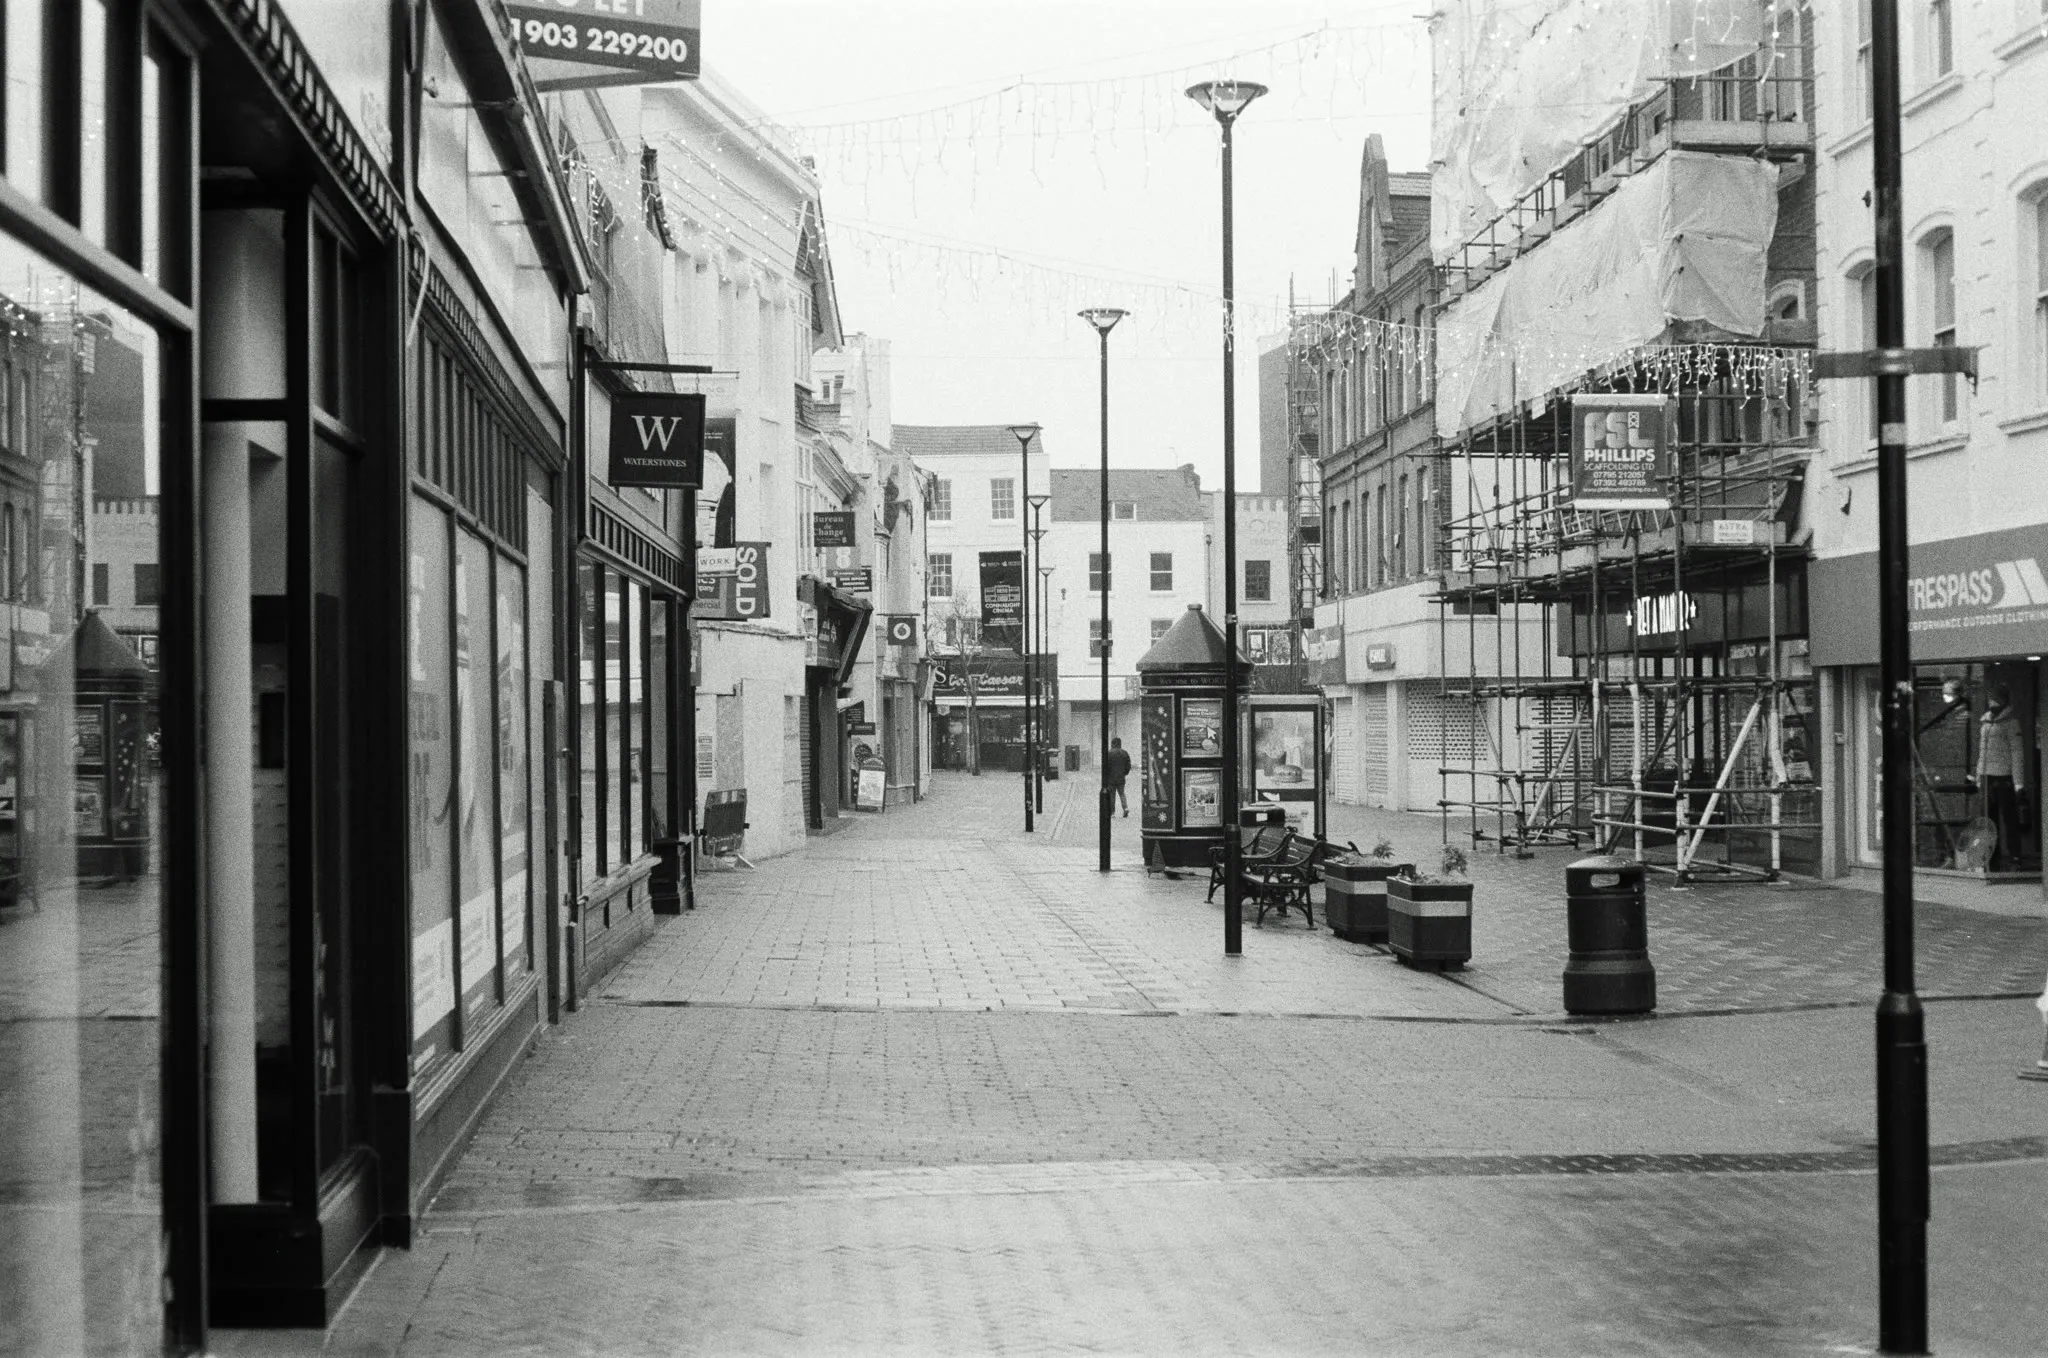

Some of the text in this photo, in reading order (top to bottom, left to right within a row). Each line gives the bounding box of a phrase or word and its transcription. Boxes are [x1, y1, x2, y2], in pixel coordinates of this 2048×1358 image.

[510, 18, 688, 63] 1903 229200
[631, 415, 683, 452] W
[1584, 411, 1656, 449] PSL
[623, 456, 687, 468] WATERSTONES
[1583, 462, 1655, 471] SCAFFOLDING LTD
[1584, 449, 1656, 462] PHILLIPS
[736, 546, 758, 615] SOLD
